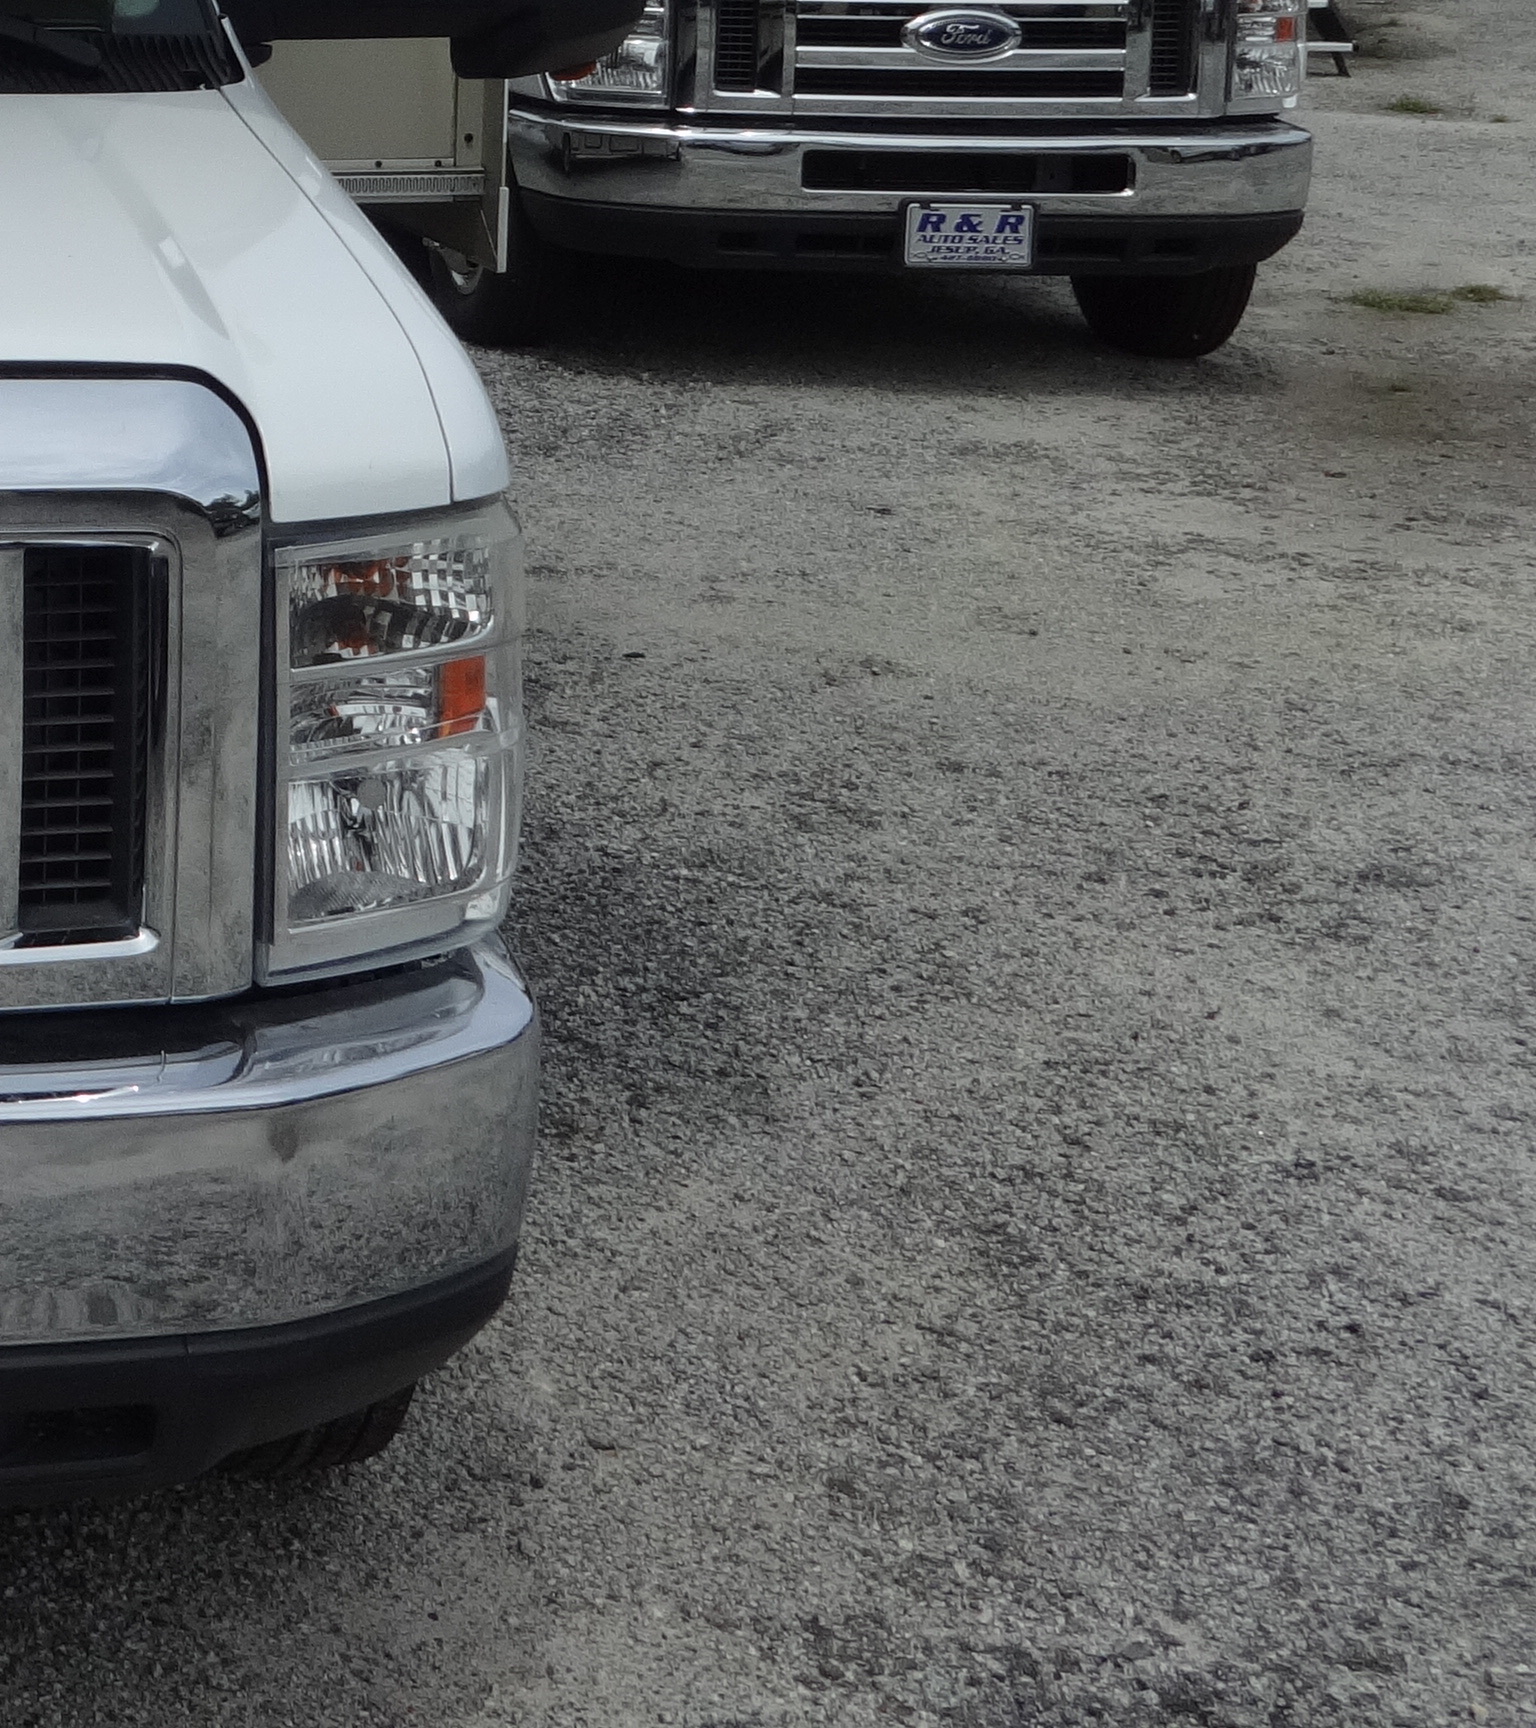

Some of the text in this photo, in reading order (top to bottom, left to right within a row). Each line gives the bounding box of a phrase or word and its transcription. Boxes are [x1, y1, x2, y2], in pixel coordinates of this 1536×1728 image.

[941, 23, 992, 45] Ford
[916, 213, 1026, 233] R & R
[916, 234, 1024, 245] AUTO SALES
